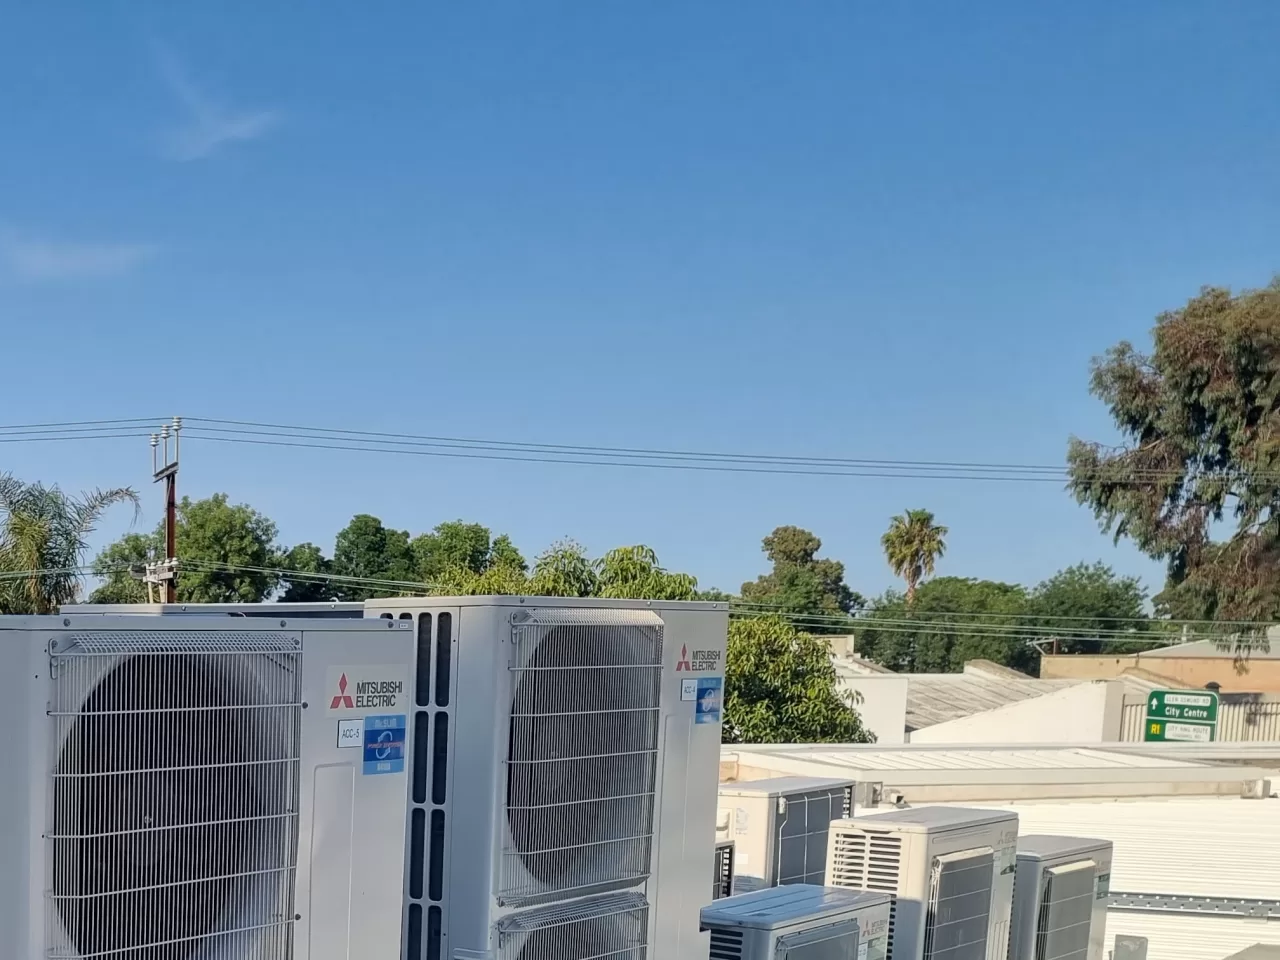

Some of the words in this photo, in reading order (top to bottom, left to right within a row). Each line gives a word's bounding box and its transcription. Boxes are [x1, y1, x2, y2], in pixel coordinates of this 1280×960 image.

[692, 651, 721, 660] MITSUBISHI
[692, 661, 717, 671] ELECTRIC
[356, 681, 403, 694] MITSUBISHI
[356, 695, 397, 708] ELECTRIC
[1165, 707, 1180, 718] City
[1184, 708, 1208, 718] Centre
[342, 728, 360, 739] ACC-5
